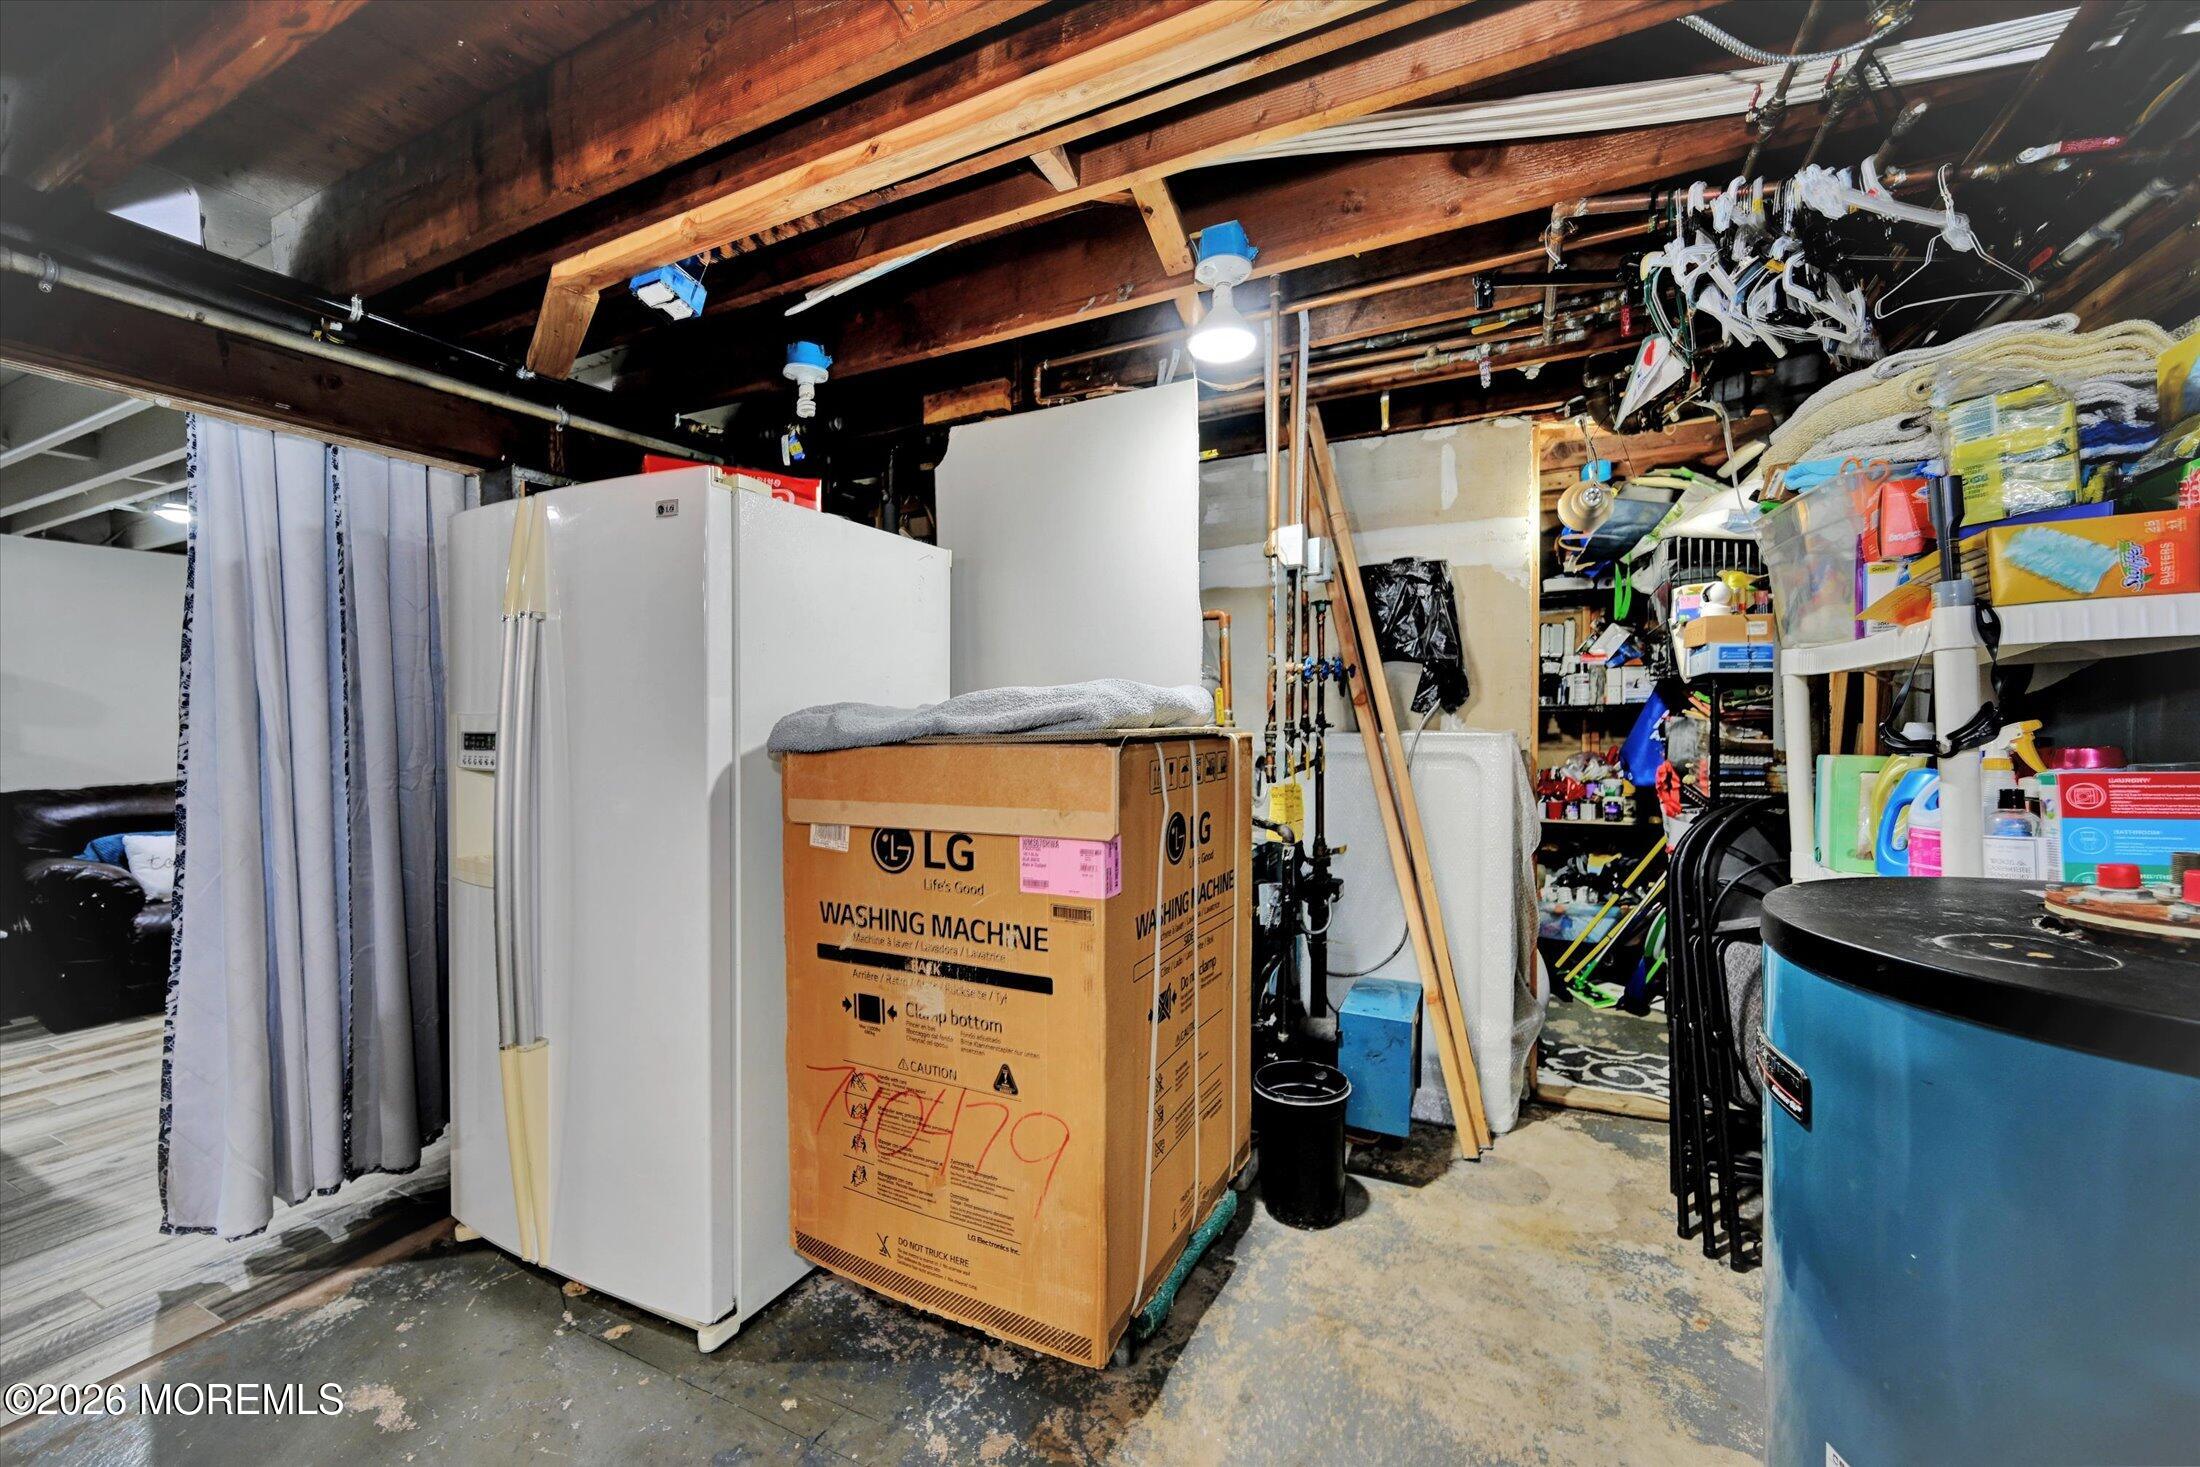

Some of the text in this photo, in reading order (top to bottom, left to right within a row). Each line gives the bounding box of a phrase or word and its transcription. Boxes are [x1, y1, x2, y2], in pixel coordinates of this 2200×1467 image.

[923, 831, 975, 872] LG
[923, 878, 984, 896] Life's Good
[819, 901, 925, 935] WASHING
[1135, 891, 1189, 941] WAHING
[950, 1009, 1004, 1034] bottom
[910, 1061, 957, 1082] CAUTION
[898, 1237, 970, 1268] DO NOT TRUCK HERE
[967, 1233, 1021, 1256] LG Electronics Inc.
